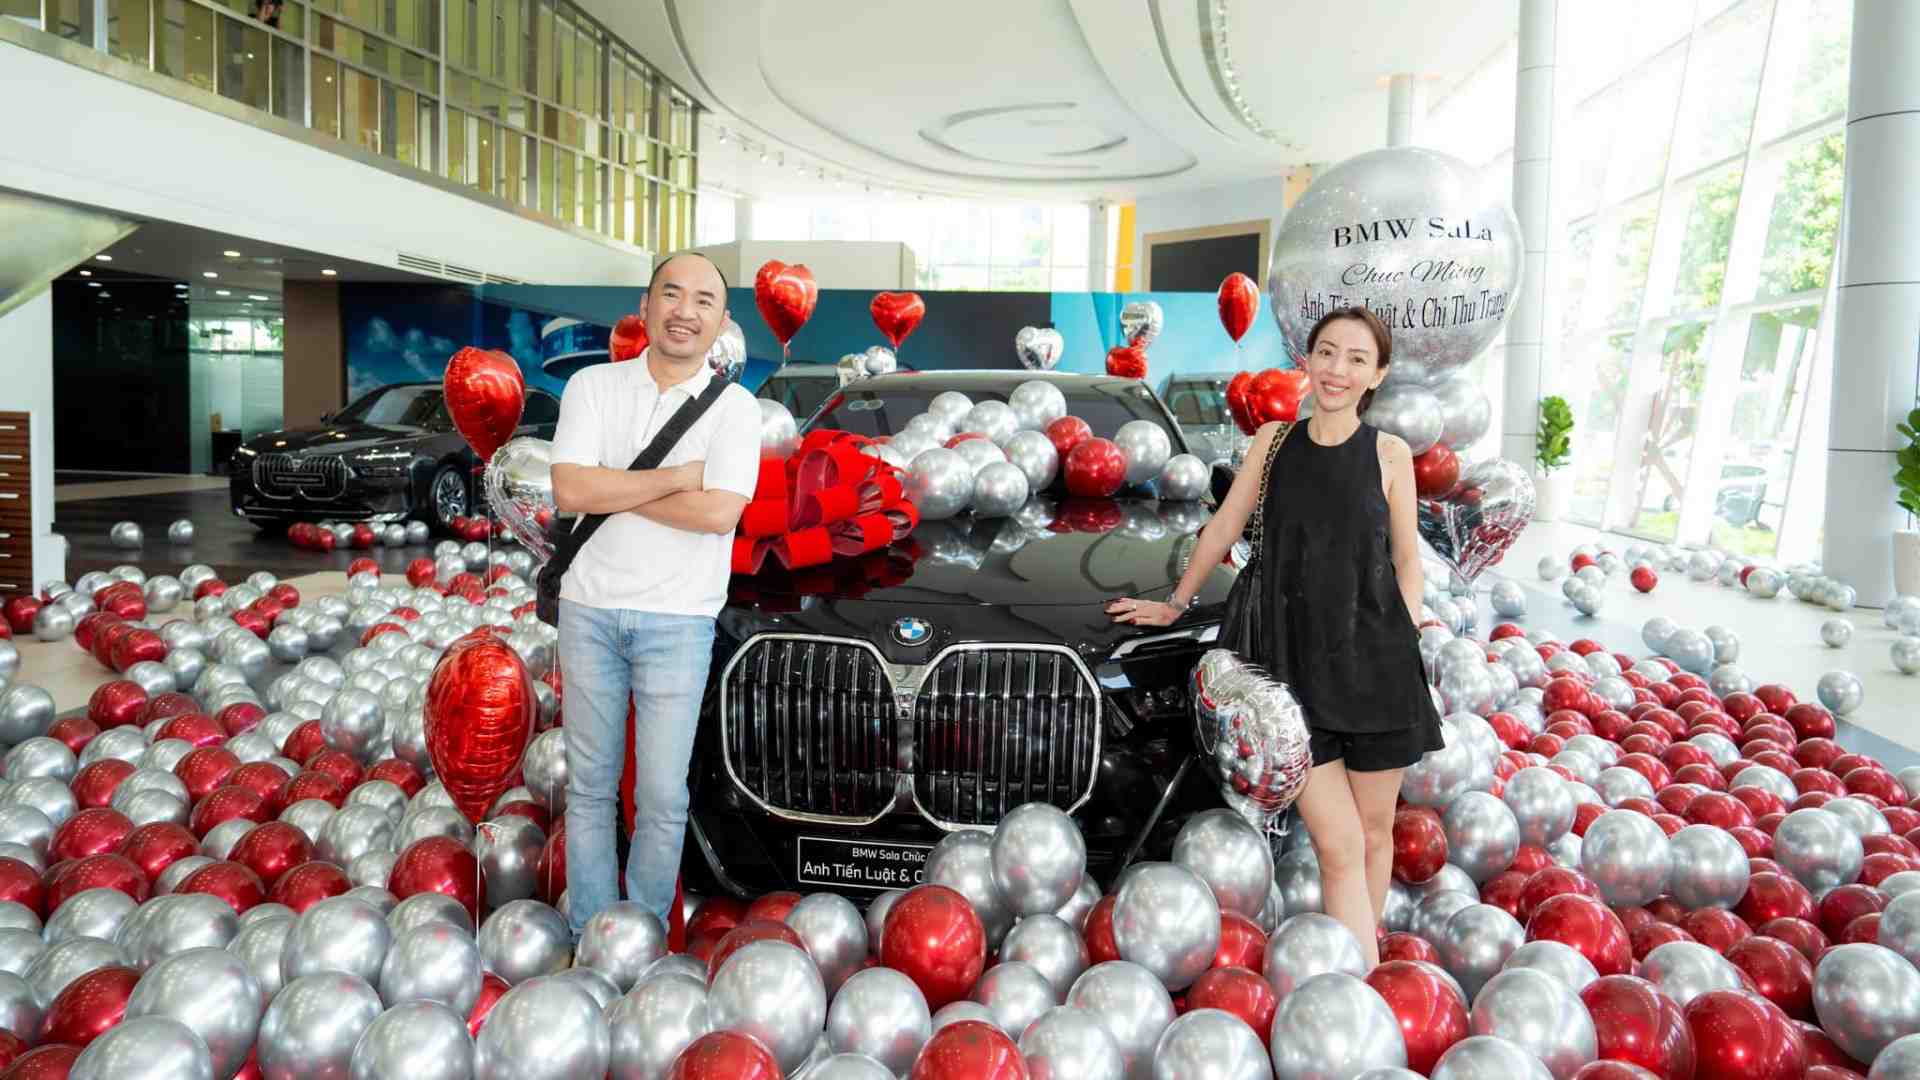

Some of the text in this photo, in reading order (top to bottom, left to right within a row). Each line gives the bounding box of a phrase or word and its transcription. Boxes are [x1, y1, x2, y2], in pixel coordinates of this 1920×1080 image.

[1333, 218, 1416, 248] BMW
[1300, 287, 1326, 321] Anh
[1402, 297, 1416, 329] &
[1452, 295, 1476, 326] Thu
[852, 847, 878, 859] BMW
[902, 850, 926, 862] Chúc
[803, 861, 830, 876] Anh
[832, 863, 862, 878] Tiến
[865, 866, 897, 884] Luật
[899, 869, 909, 882] &
